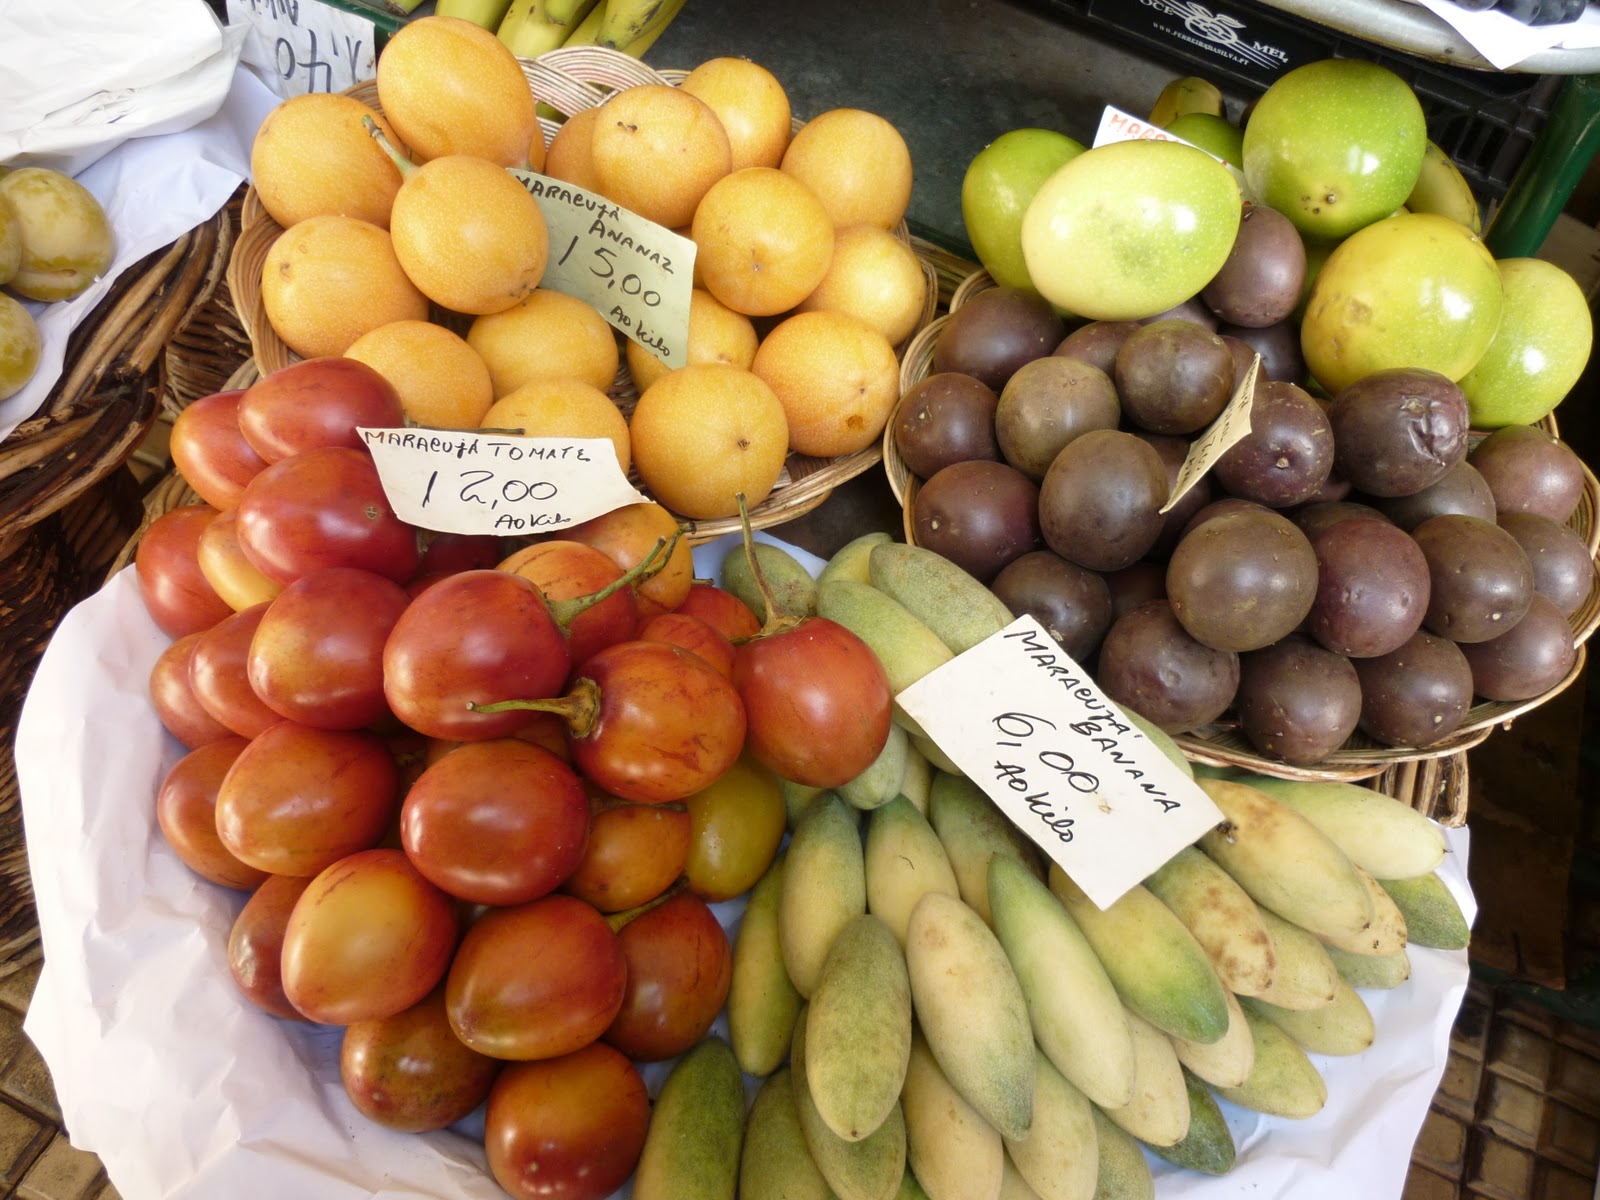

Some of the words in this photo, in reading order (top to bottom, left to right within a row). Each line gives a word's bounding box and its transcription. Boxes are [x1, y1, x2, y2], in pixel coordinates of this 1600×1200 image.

[558, 235, 661, 307] 15,00
[588, 219, 674, 274] ANANAZ
[487, 442, 591, 462] TOMATE
[421, 470, 558, 510] 12,00
[991, 711, 1099, 794] 6,00
[1069, 721, 1182, 813] BANANA
